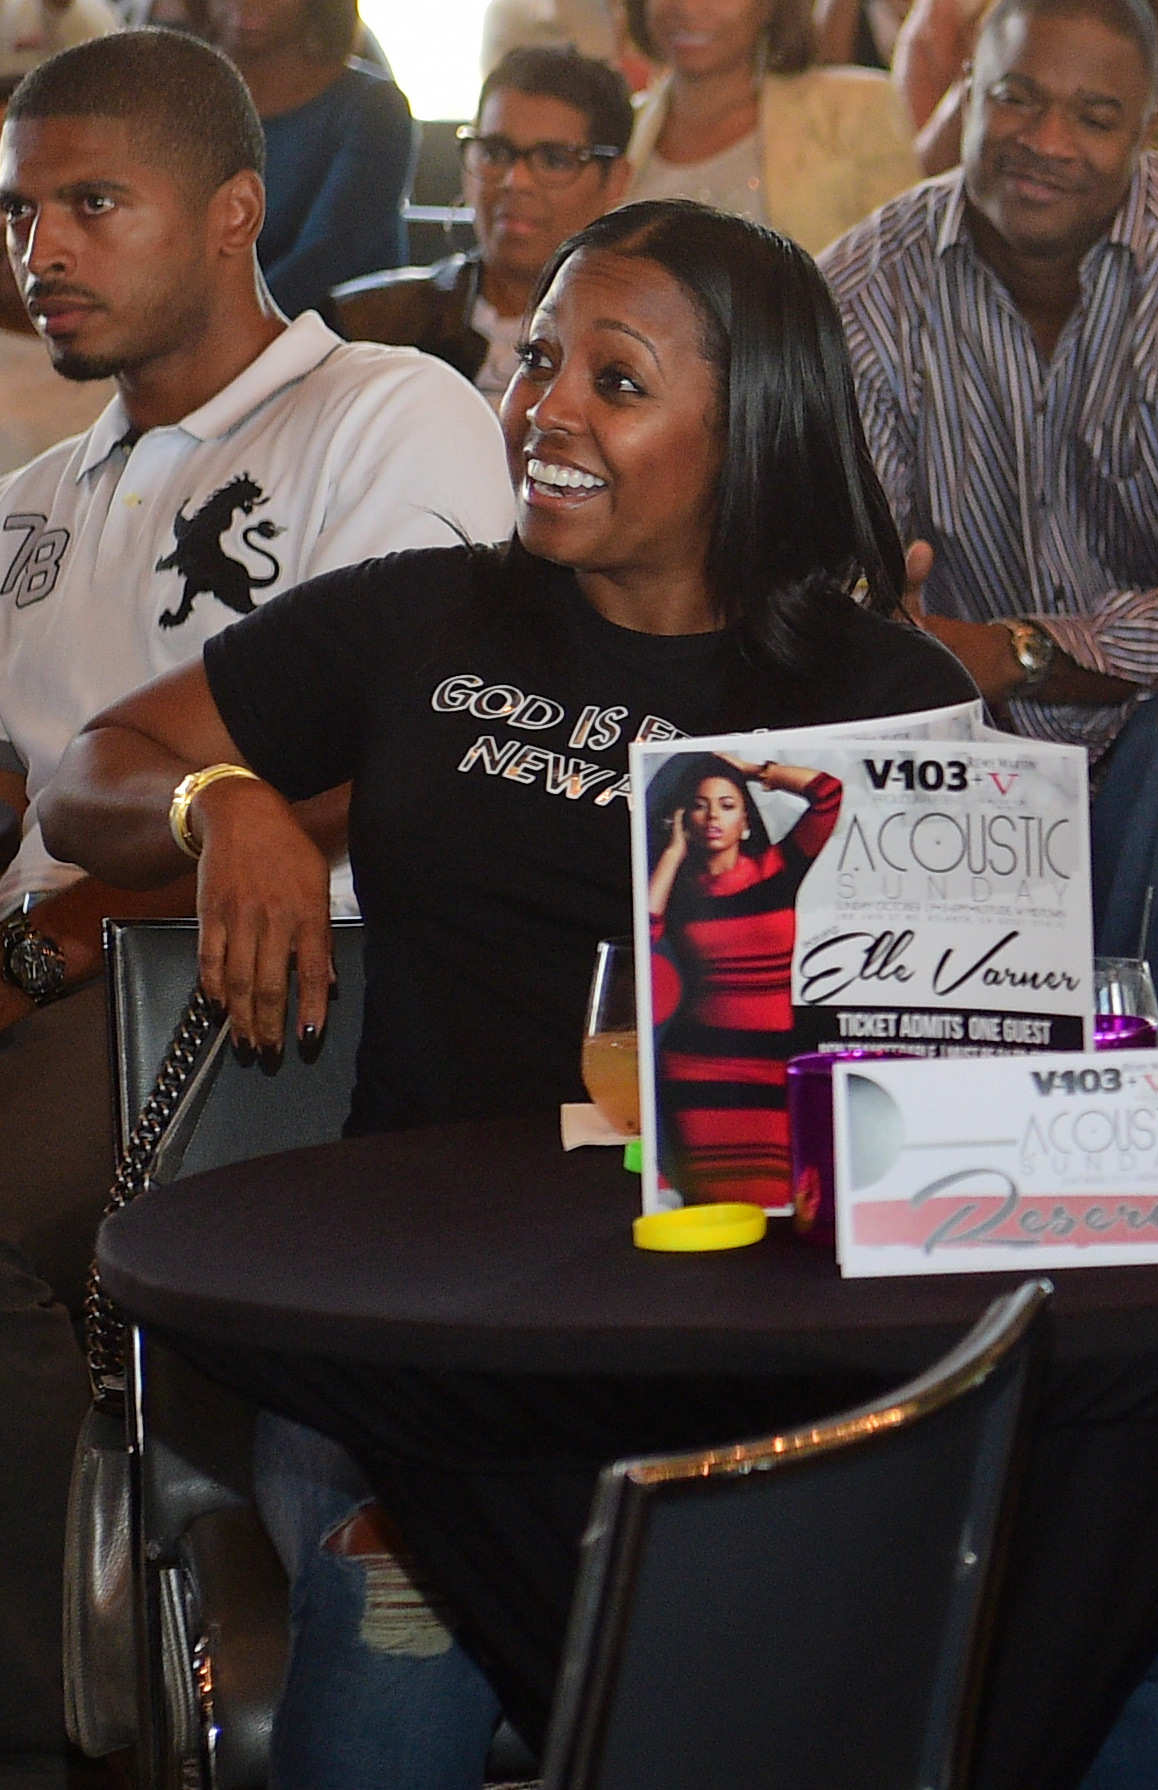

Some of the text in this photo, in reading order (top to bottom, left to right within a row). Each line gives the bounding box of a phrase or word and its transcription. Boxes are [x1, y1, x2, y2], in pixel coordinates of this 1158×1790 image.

[1, 513, 70, 609] 78
[431, 674, 565, 730] GOD
[568, 705, 628, 750] IS
[865, 758, 1019, 796] V-103 V
[837, 811, 1070, 880] ACOUSTIC
[837, 873, 1069, 902] SUNDAY
[800, 929, 1080, 1005] Elle Varner
[836, 1012, 1052, 1045] TICKET ADMITS ONE GUEST
[1031, 1067, 1122, 1097] V-103
